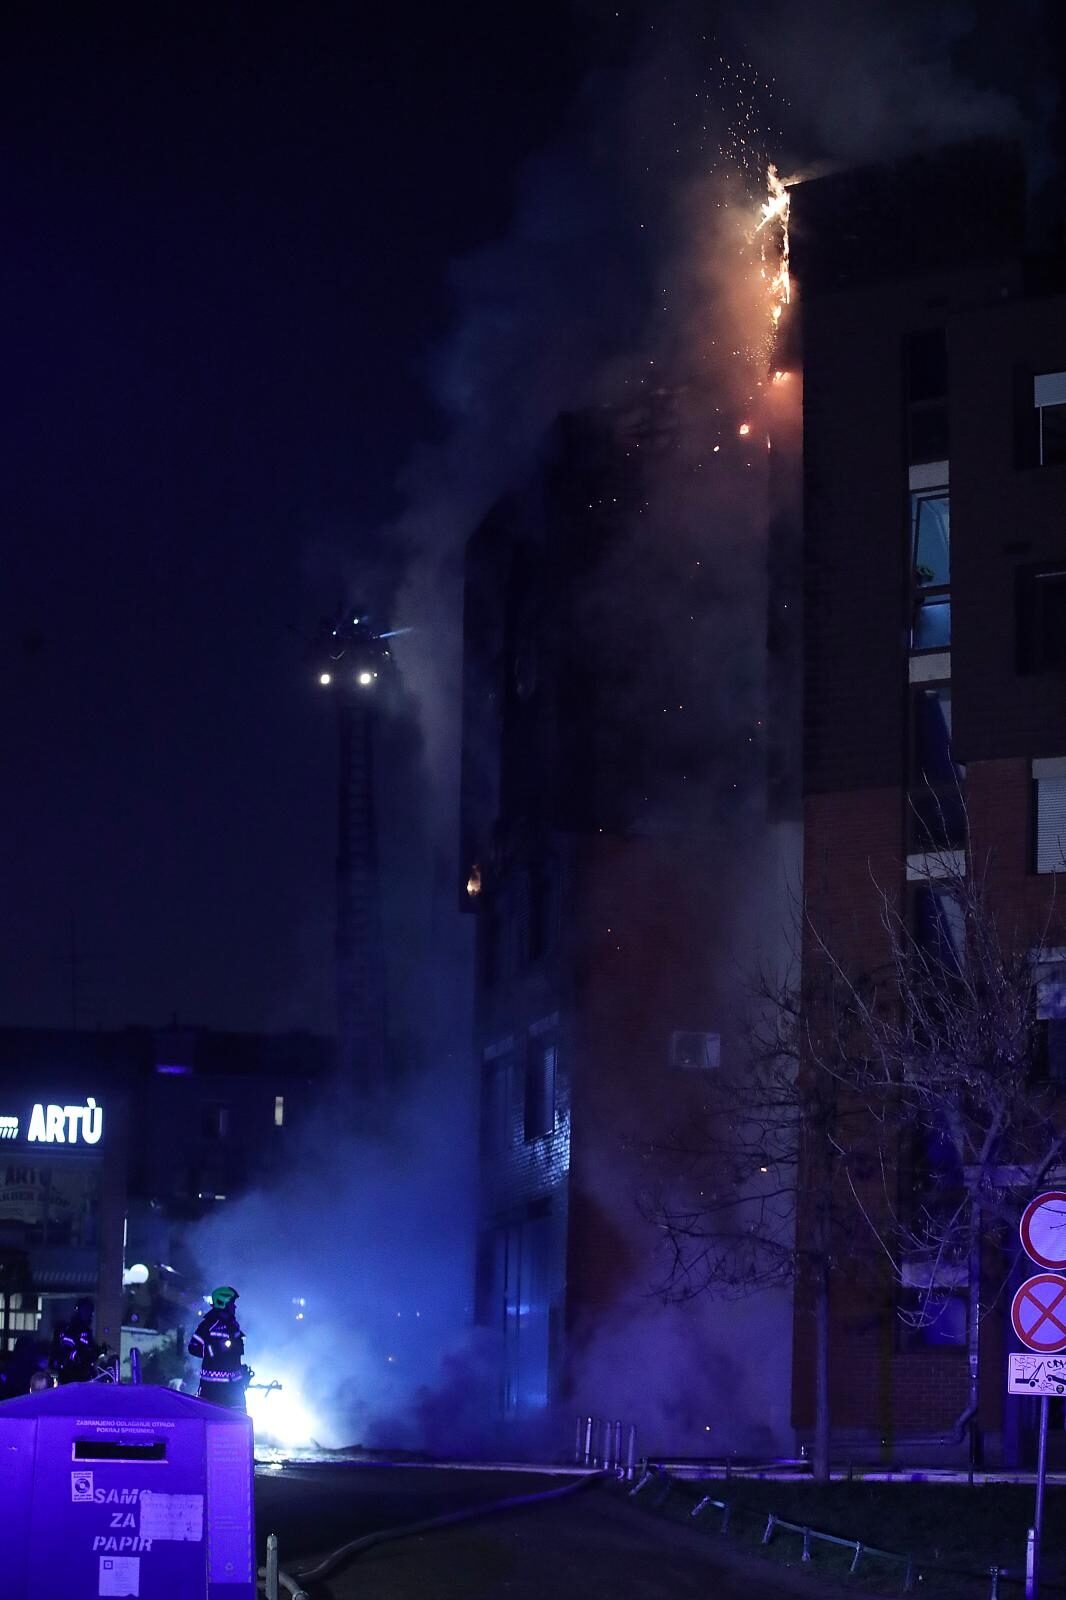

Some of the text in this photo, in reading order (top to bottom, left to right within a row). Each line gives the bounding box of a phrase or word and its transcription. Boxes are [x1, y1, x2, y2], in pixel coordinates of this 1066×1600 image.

[27, 1097, 103, 1144] ARTÙ
[109, 1512, 136, 1528] ZA
[92, 1535, 153, 1552] PAPIR
